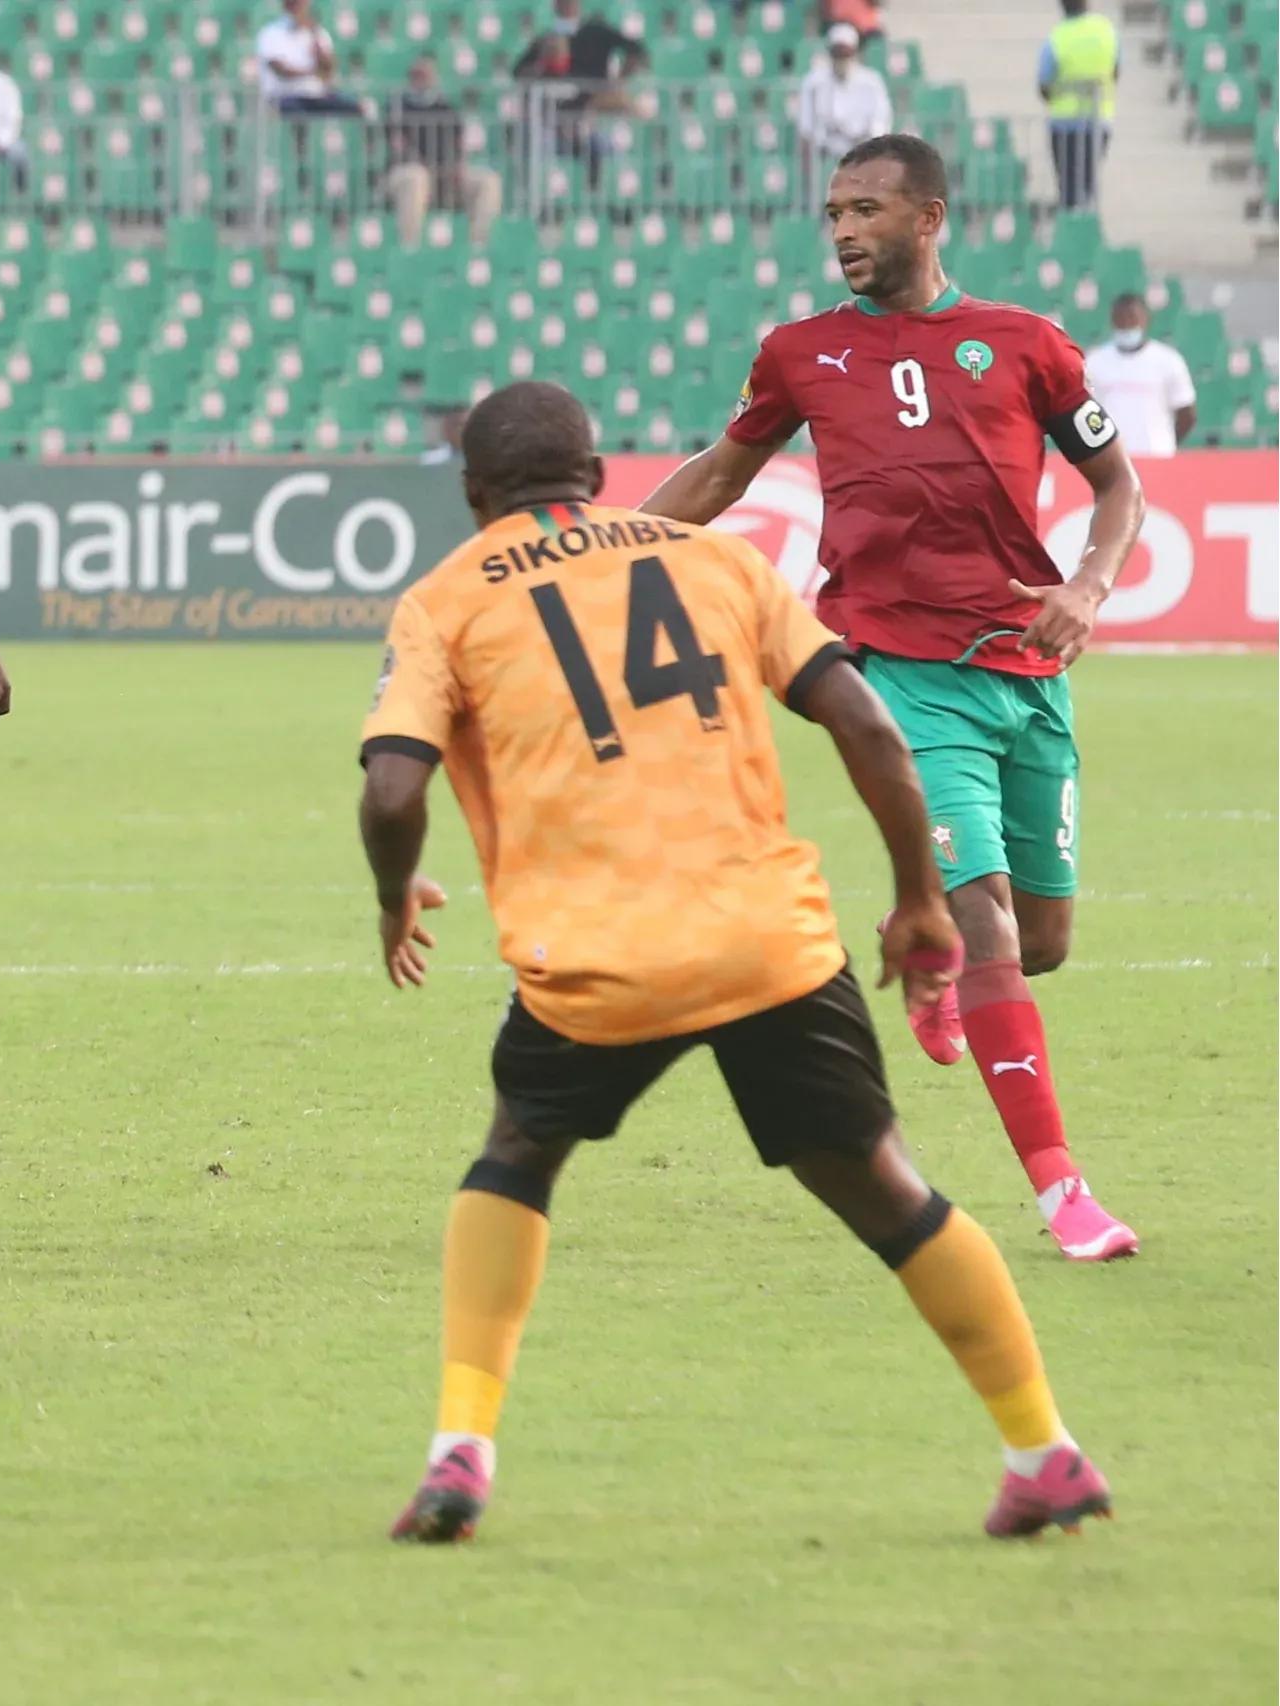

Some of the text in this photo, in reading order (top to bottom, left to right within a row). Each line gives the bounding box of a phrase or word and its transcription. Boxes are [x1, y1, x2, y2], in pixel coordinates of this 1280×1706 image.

[890, 358, 930, 428] 9
[481, 520, 692, 584] SIKOMBE
[1037, 473, 1279, 623] OT
[41, 591, 102, 628] The
[108, 590, 179, 630] Star
[184, 585, 227, 638] of
[529, 555, 729, 765] 14
[1056, 779, 1074, 849] 9
